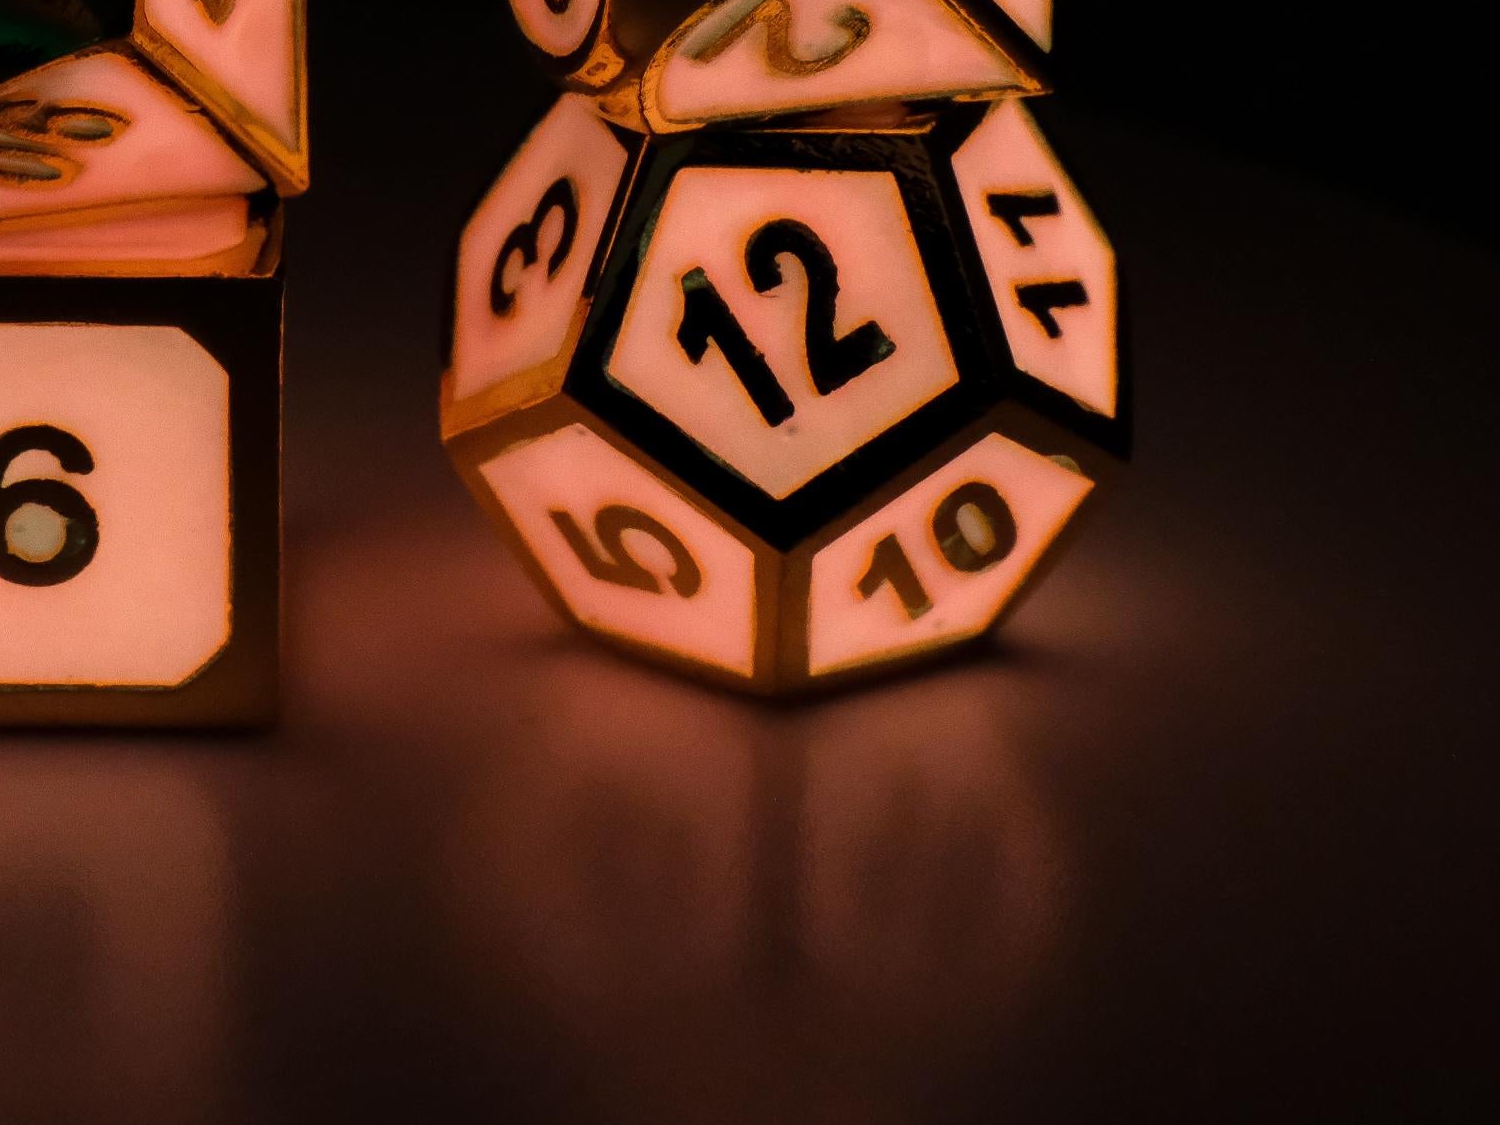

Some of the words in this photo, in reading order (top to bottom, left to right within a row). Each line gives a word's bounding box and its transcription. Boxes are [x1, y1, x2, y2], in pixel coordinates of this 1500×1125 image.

[489, 177, 579, 317] 3
[986, 188, 1090, 339] 11
[677, 218, 896, 428] 12
[549, 504, 702, 600] 5
[857, 480, 1018, 620] 10
